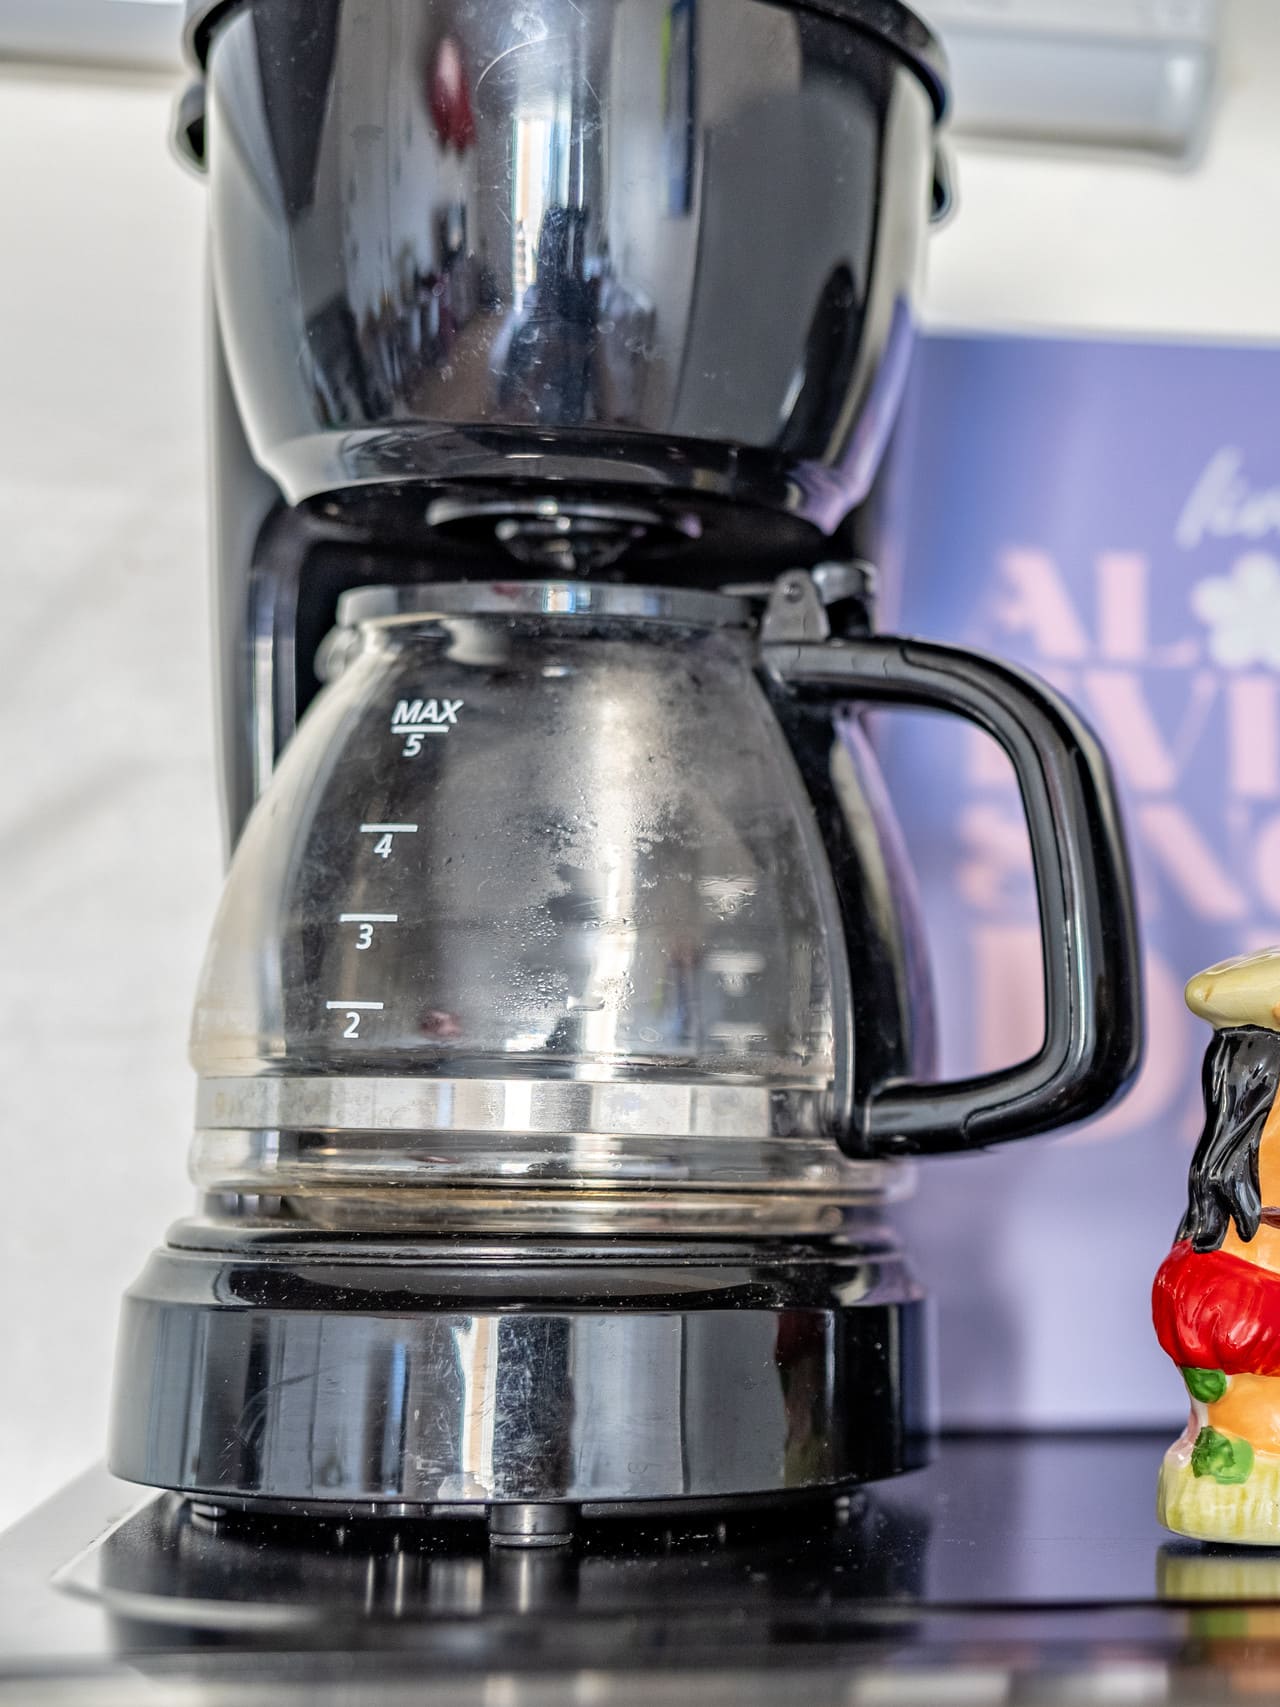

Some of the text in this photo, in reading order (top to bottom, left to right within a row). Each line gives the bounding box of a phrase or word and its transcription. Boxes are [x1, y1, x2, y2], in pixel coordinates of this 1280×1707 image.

[391, 698, 464, 725] MAX
[402, 733, 425, 757] 5
[373, 833, 393, 858] 4
[355, 923, 374, 950] 3
[343, 1011, 361, 1039] 2
